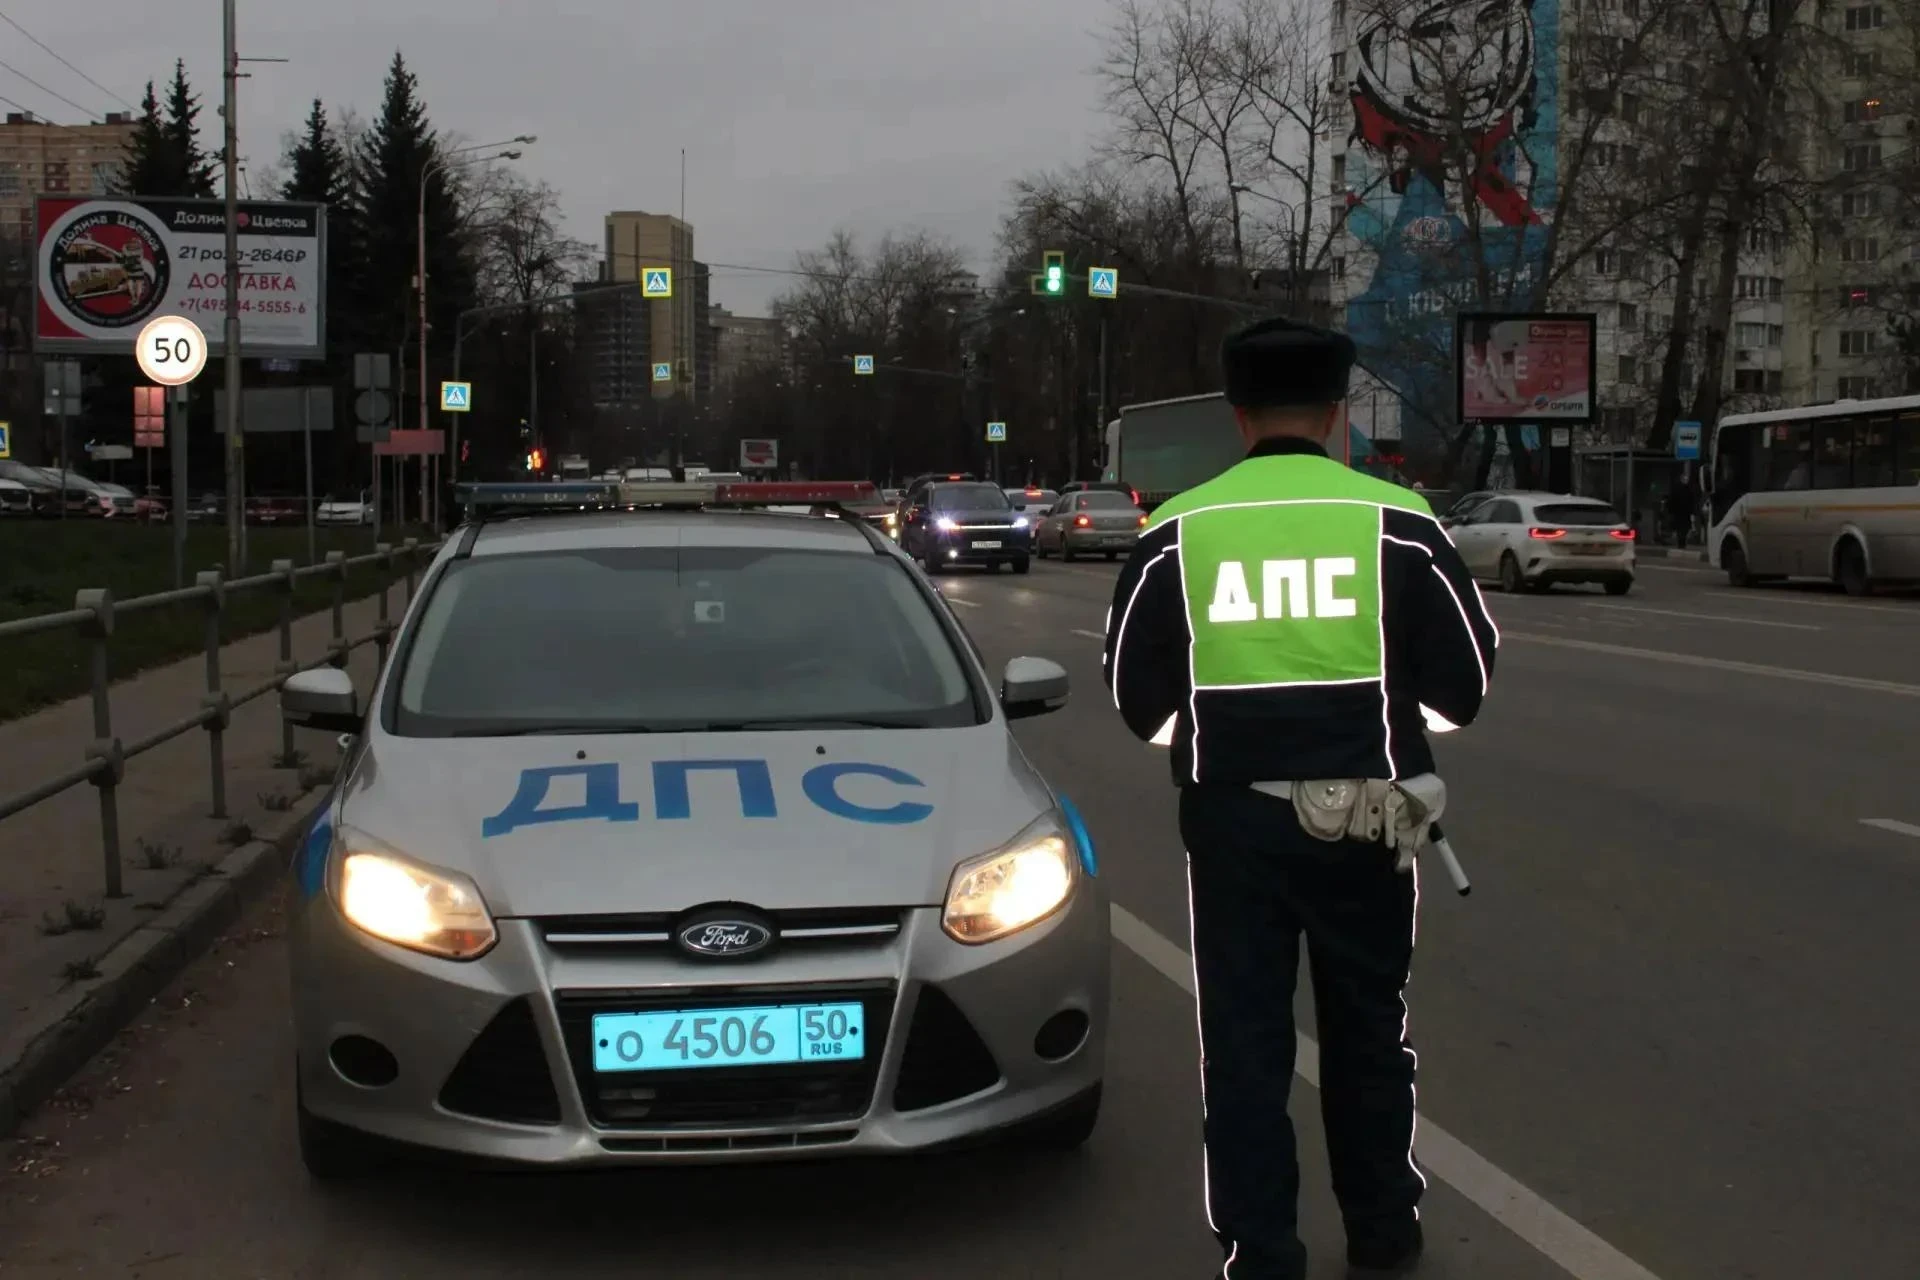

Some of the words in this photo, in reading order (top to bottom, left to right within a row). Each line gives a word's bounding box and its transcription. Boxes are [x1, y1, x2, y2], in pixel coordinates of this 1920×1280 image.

[174, 210, 227, 226] Долин
[178, 246, 198, 259] 21
[154, 337, 191, 364] 50
[1465, 354, 1529, 380] SALE
[1208, 557, 1357, 623] ДПС
[482, 759, 935, 838] ДПС
[700, 924, 750, 948] Ford
[662, 1014, 776, 1061] 4506
[805, 1009, 848, 1042] 50
[810, 1042, 843, 1056] RUS
